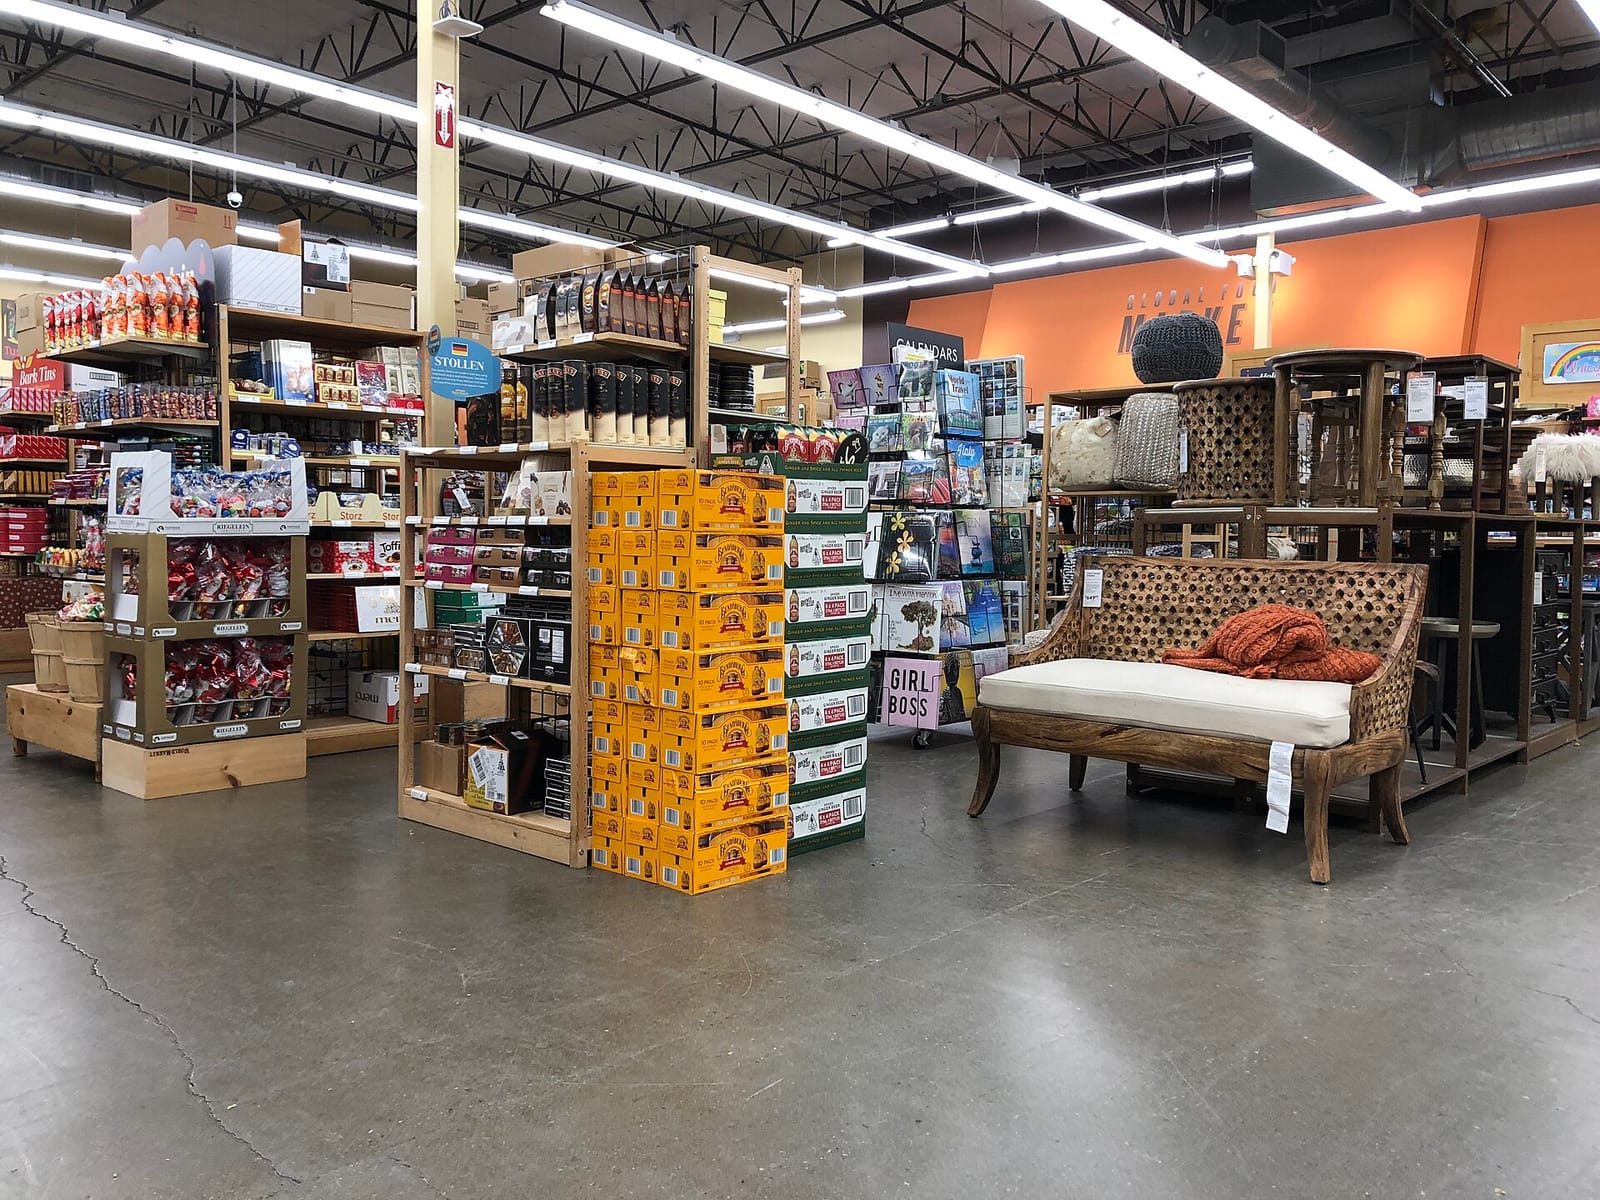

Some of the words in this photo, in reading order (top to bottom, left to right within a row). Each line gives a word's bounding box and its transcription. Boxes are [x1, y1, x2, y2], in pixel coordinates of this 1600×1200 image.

[1126, 287, 1204, 310] GLOBAL
[434, 355, 485, 371] STOLLEN
[19, 367, 38, 386] Bark
[39, 366, 57, 382] Tins
[956, 442, 976, 461] Italy
[340, 511, 363, 520] Storz
[382, 512, 401, 521] Stor
[216, 523, 250, 531] RIEGELEIN
[379, 540, 401, 553] Toffi
[375, 614, 400, 625] mer
[216, 624, 246, 632] RIEGELEIN
[890, 667, 930, 693] GIRL
[354, 693, 379, 704] merci
[888, 695, 928, 717] BOSS
